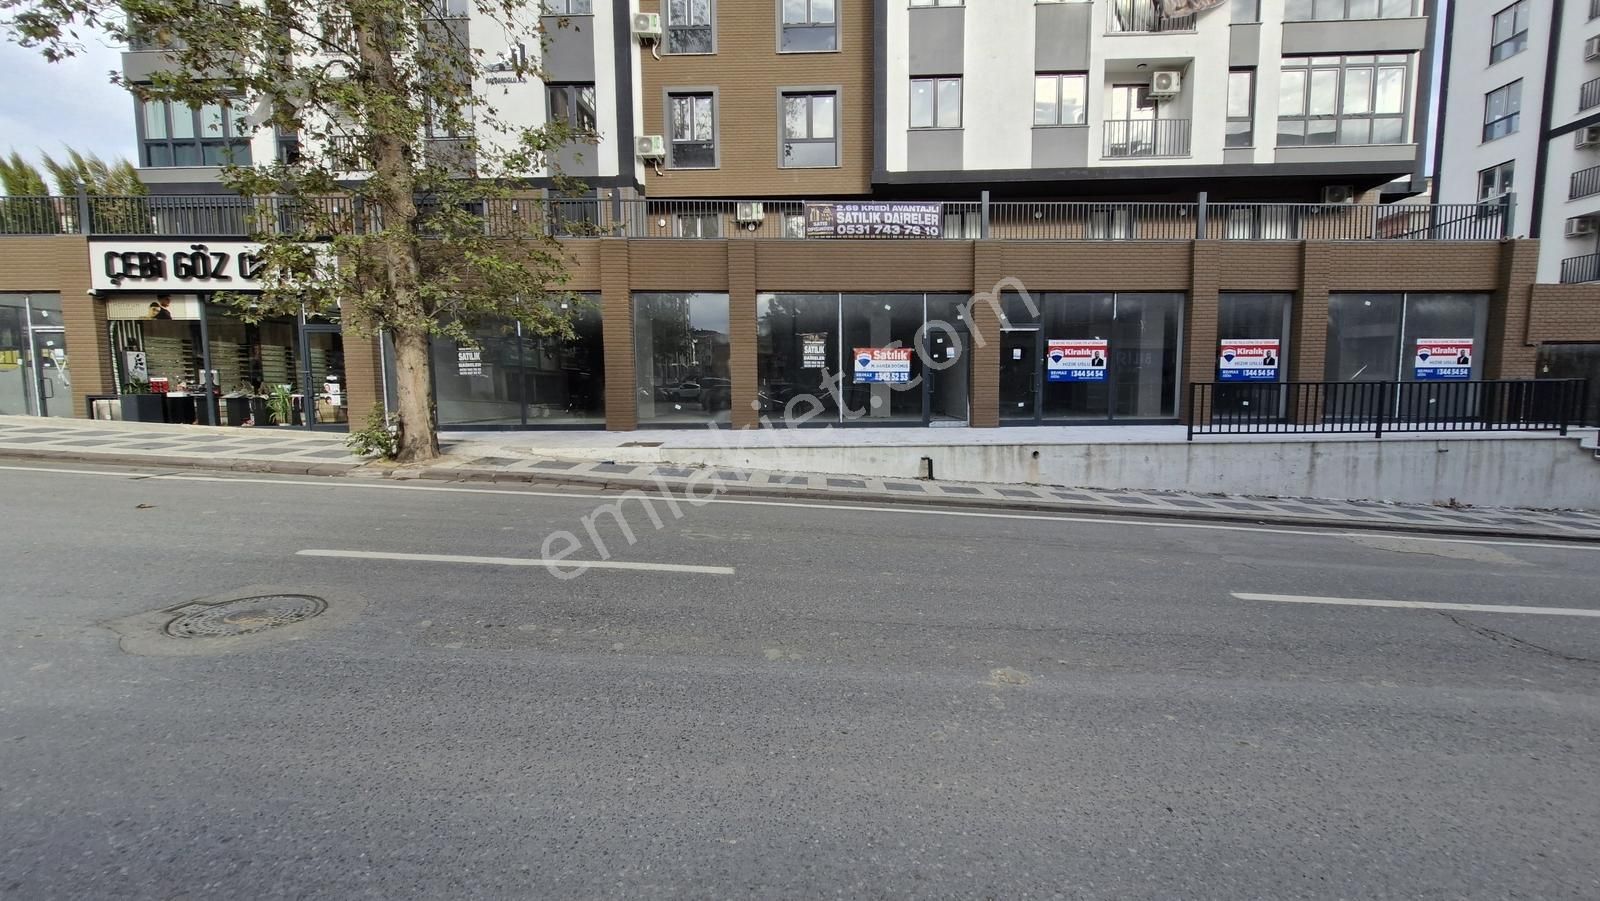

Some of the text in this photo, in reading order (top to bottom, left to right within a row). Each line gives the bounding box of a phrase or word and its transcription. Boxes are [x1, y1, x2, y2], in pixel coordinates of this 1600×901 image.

[892, 205, 939, 213] AVANTAJLI
[836, 212, 881, 224] SATILIK
[836, 224, 870, 234] 0531
[874, 224, 900, 235] 743
[173, 244, 232, 282] GÖZ
[804, 345, 824, 354] SATILIK
[1064, 348, 1092, 356] Kiralık
[458, 352, 480, 360] SATILIK
[873, 350, 908, 360] Satılık
[891, 372, 899, 381] 52
[900, 373, 908, 381] 53
